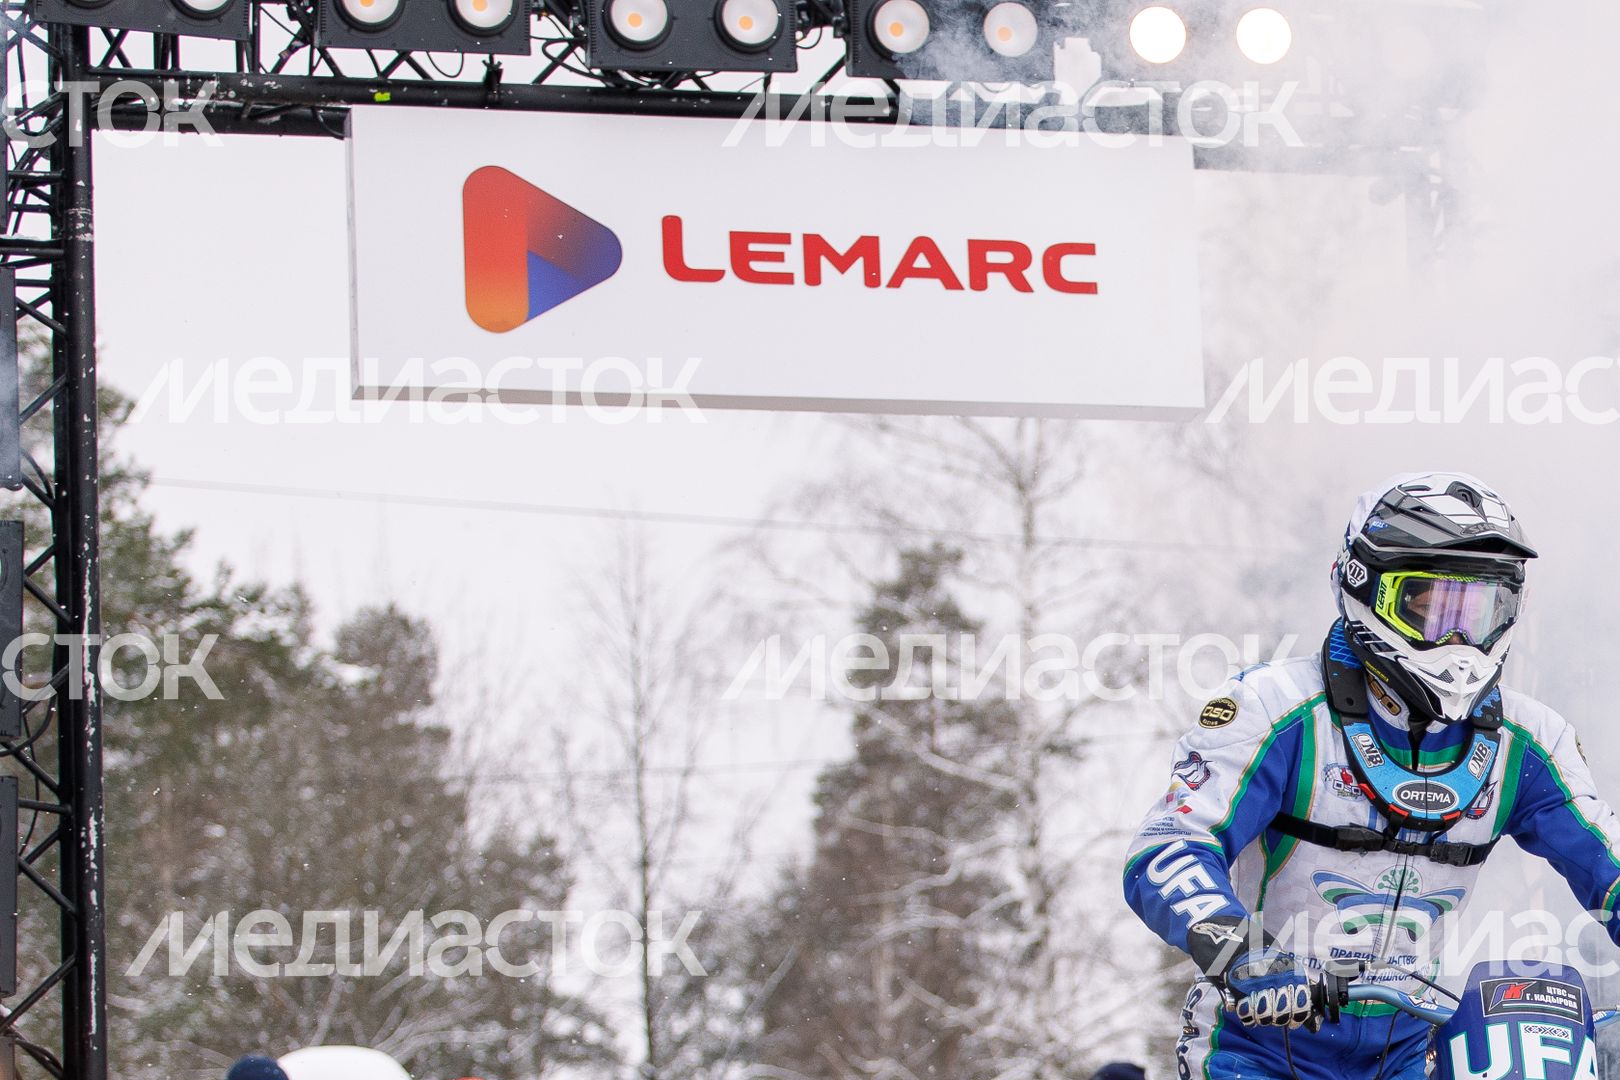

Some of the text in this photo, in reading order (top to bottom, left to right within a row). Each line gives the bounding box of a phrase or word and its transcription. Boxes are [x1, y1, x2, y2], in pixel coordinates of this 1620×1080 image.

[661, 215, 1098, 295] LEMARC
[1400, 789, 1451, 804] ORTEMA
[1146, 839, 1230, 928] UFA
[1534, 993, 1578, 1009] КАДЫРОВА
